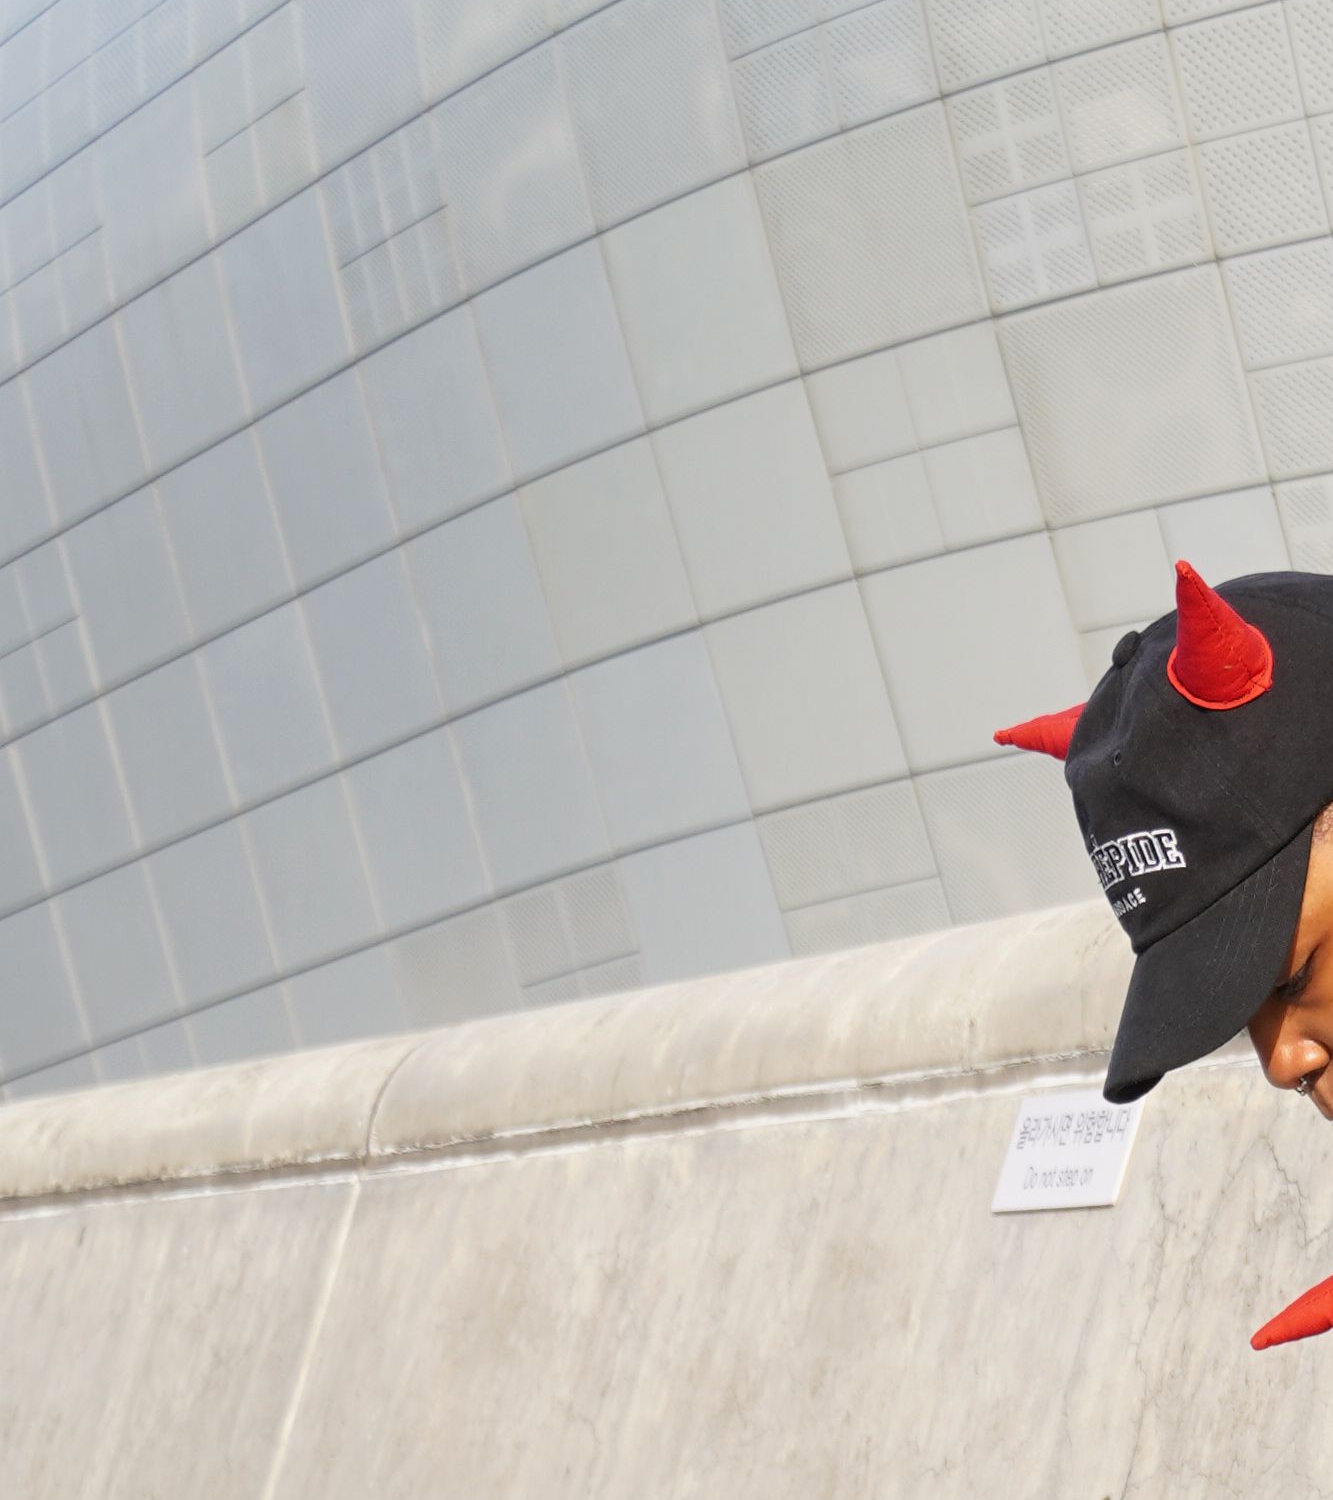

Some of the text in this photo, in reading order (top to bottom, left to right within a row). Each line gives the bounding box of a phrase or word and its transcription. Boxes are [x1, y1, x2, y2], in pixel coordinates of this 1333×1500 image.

[1017, 1108, 1131, 1150] 올라가시면 위험합니다
[1023, 1166, 1094, 1191] Do not step on
